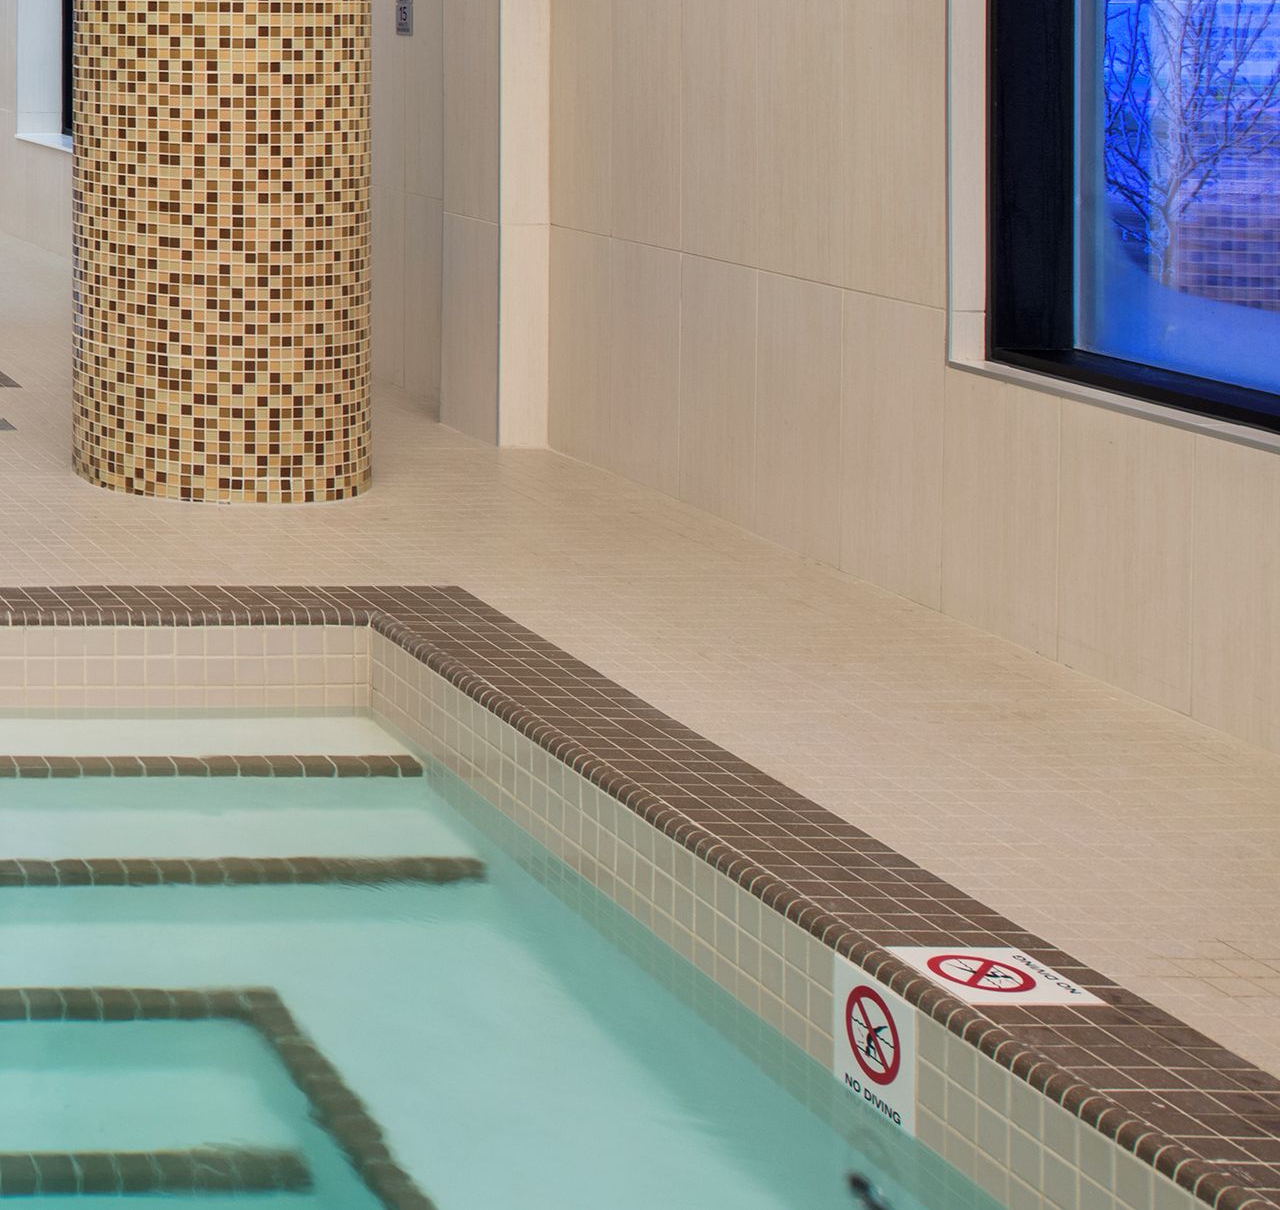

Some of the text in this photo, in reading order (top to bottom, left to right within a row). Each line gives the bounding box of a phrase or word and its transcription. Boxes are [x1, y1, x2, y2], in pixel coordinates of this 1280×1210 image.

[400, 7, 407, 21] 15
[845, 1072, 901, 1126] NO DIVING
